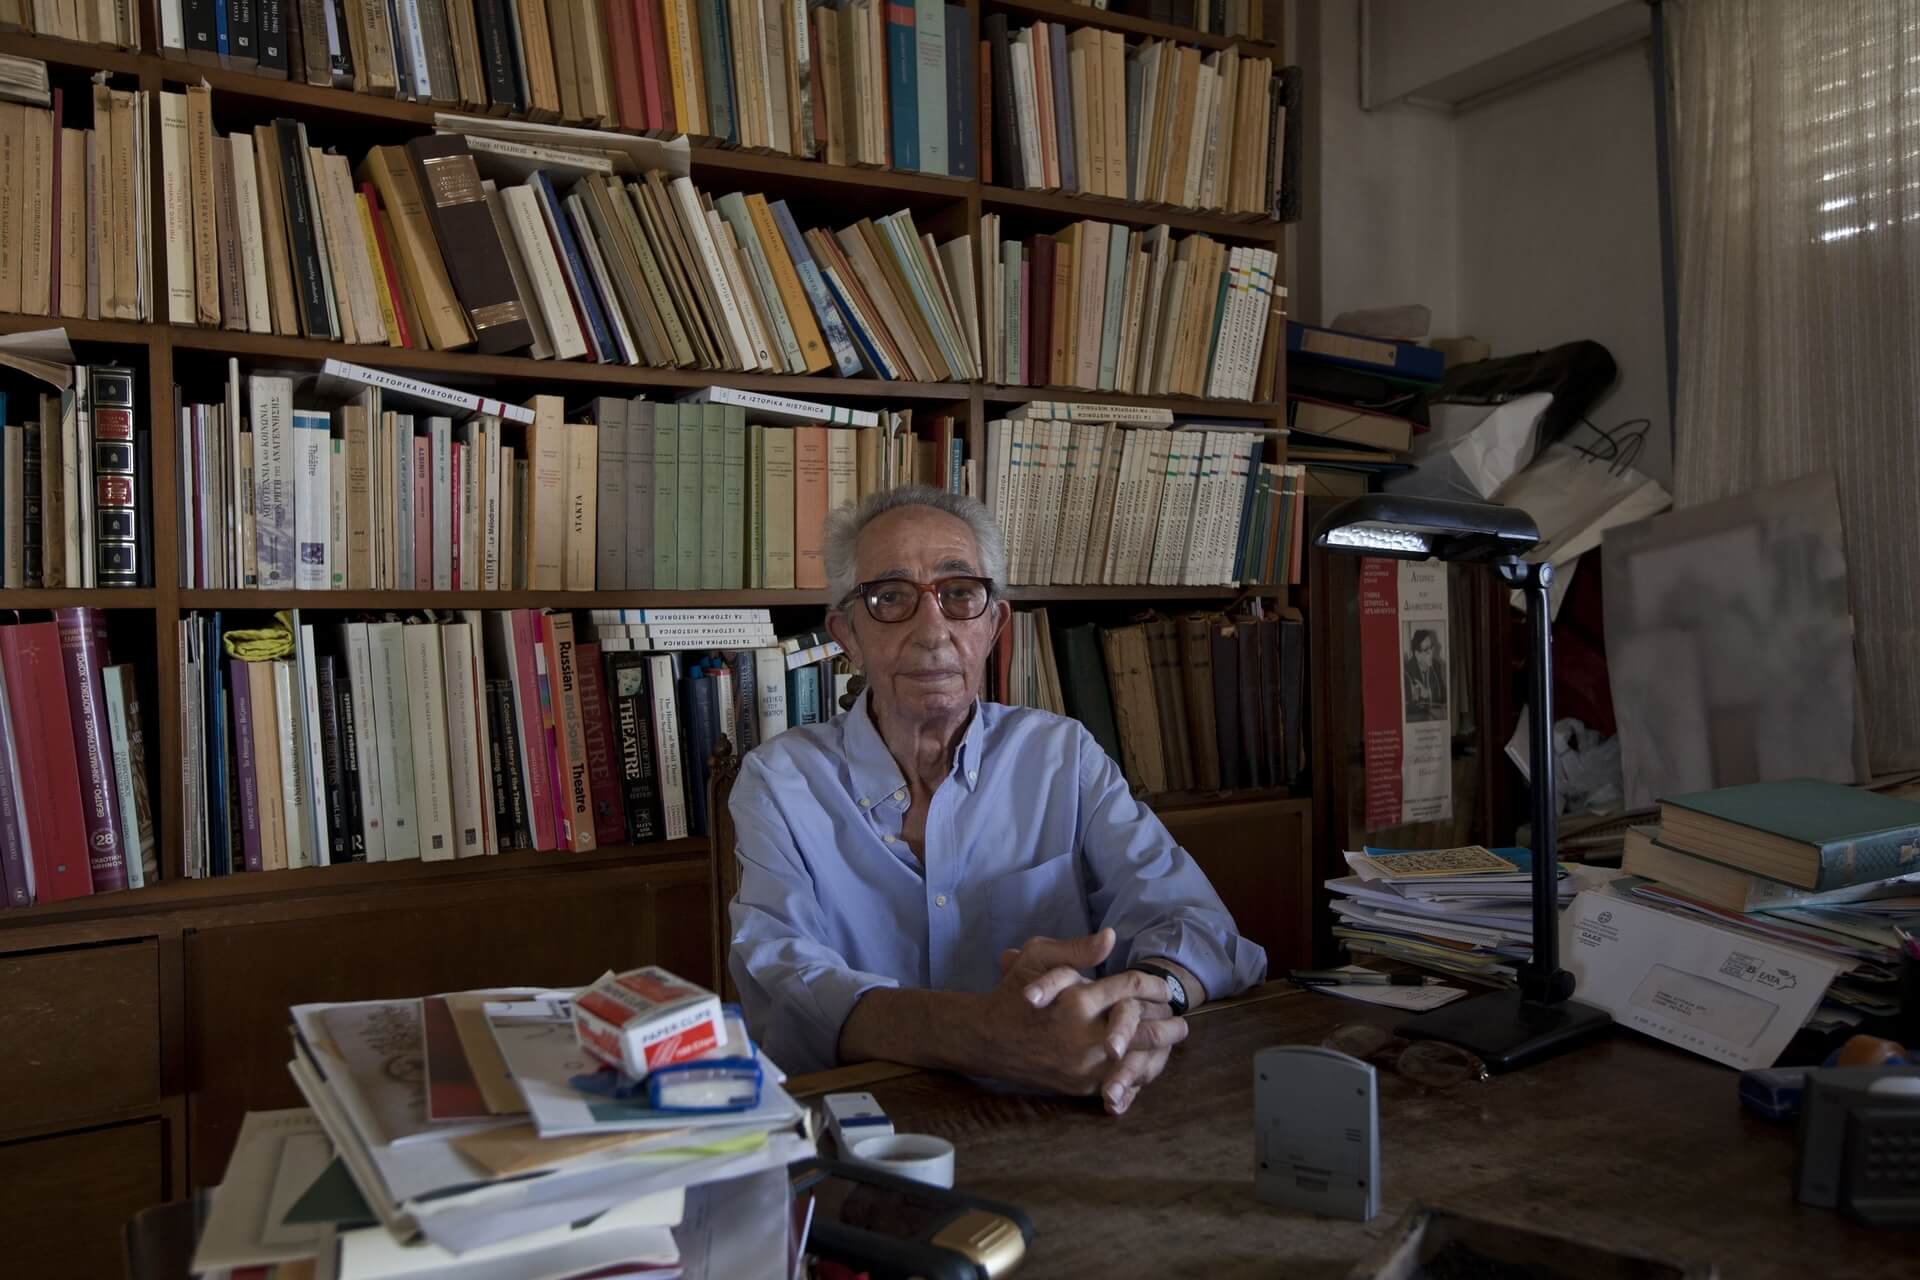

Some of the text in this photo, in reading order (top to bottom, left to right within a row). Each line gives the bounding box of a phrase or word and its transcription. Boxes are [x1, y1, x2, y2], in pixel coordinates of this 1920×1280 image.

[375, 377, 418, 391] ΙΣΤΟΡΙΚΑ
[421, 387, 468, 404] HISTORICA
[737, 393, 824, 414] ΤΑ ΙΣΤΟΡΙΚΑ HISTORICA
[260, 404, 269, 447] ΚΟΙΝΩΝΙΑ
[272, 397, 281, 463] ΑΝΑΓΕΝΝΗΣΗΣ
[262, 463, 274, 520] ΛΟΓΟΤΕΧΝΙΑ
[559, 641, 573, 692] Russian
[503, 703, 513, 734] Concise
[564, 694, 578, 721] and
[584, 667, 609, 780] THEATRE
[345, 693, 357, 771] systems of rehearsal
[619, 698, 639, 780] THEATRE
[505, 736, 515, 765] History
[510, 767, 517, 775] of
[511, 777, 519, 790] the
[572, 763, 588, 813] Theatre
[513, 791, 522, 823] Theatre
[96, 833, 113, 846] 28
[642, 1009, 711, 1042] PAPER CLIPS
